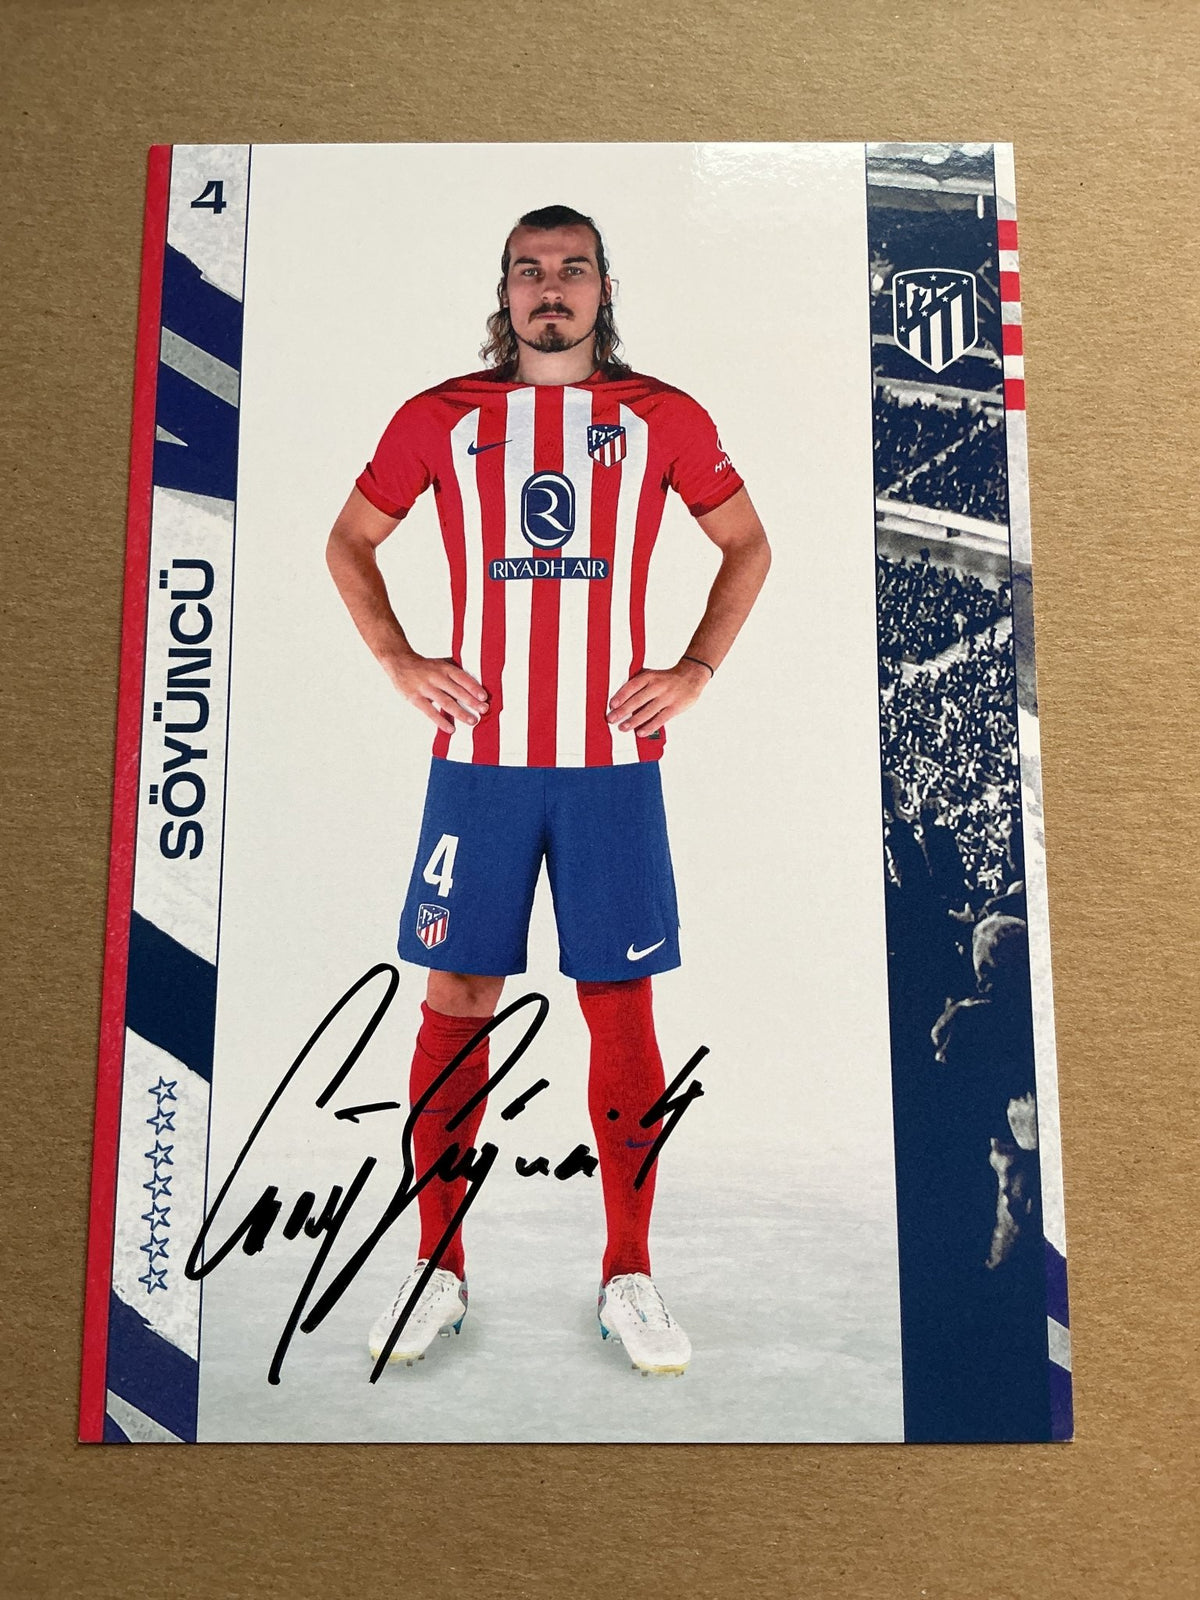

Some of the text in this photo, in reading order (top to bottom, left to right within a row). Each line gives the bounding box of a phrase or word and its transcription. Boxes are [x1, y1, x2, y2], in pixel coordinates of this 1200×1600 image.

[190, 180, 227, 215] 4
[492, 560, 606, 579] RIYADH AIR
[149, 558, 215, 860] SÖYÜNCÜ
[422, 833, 459, 898] 4
